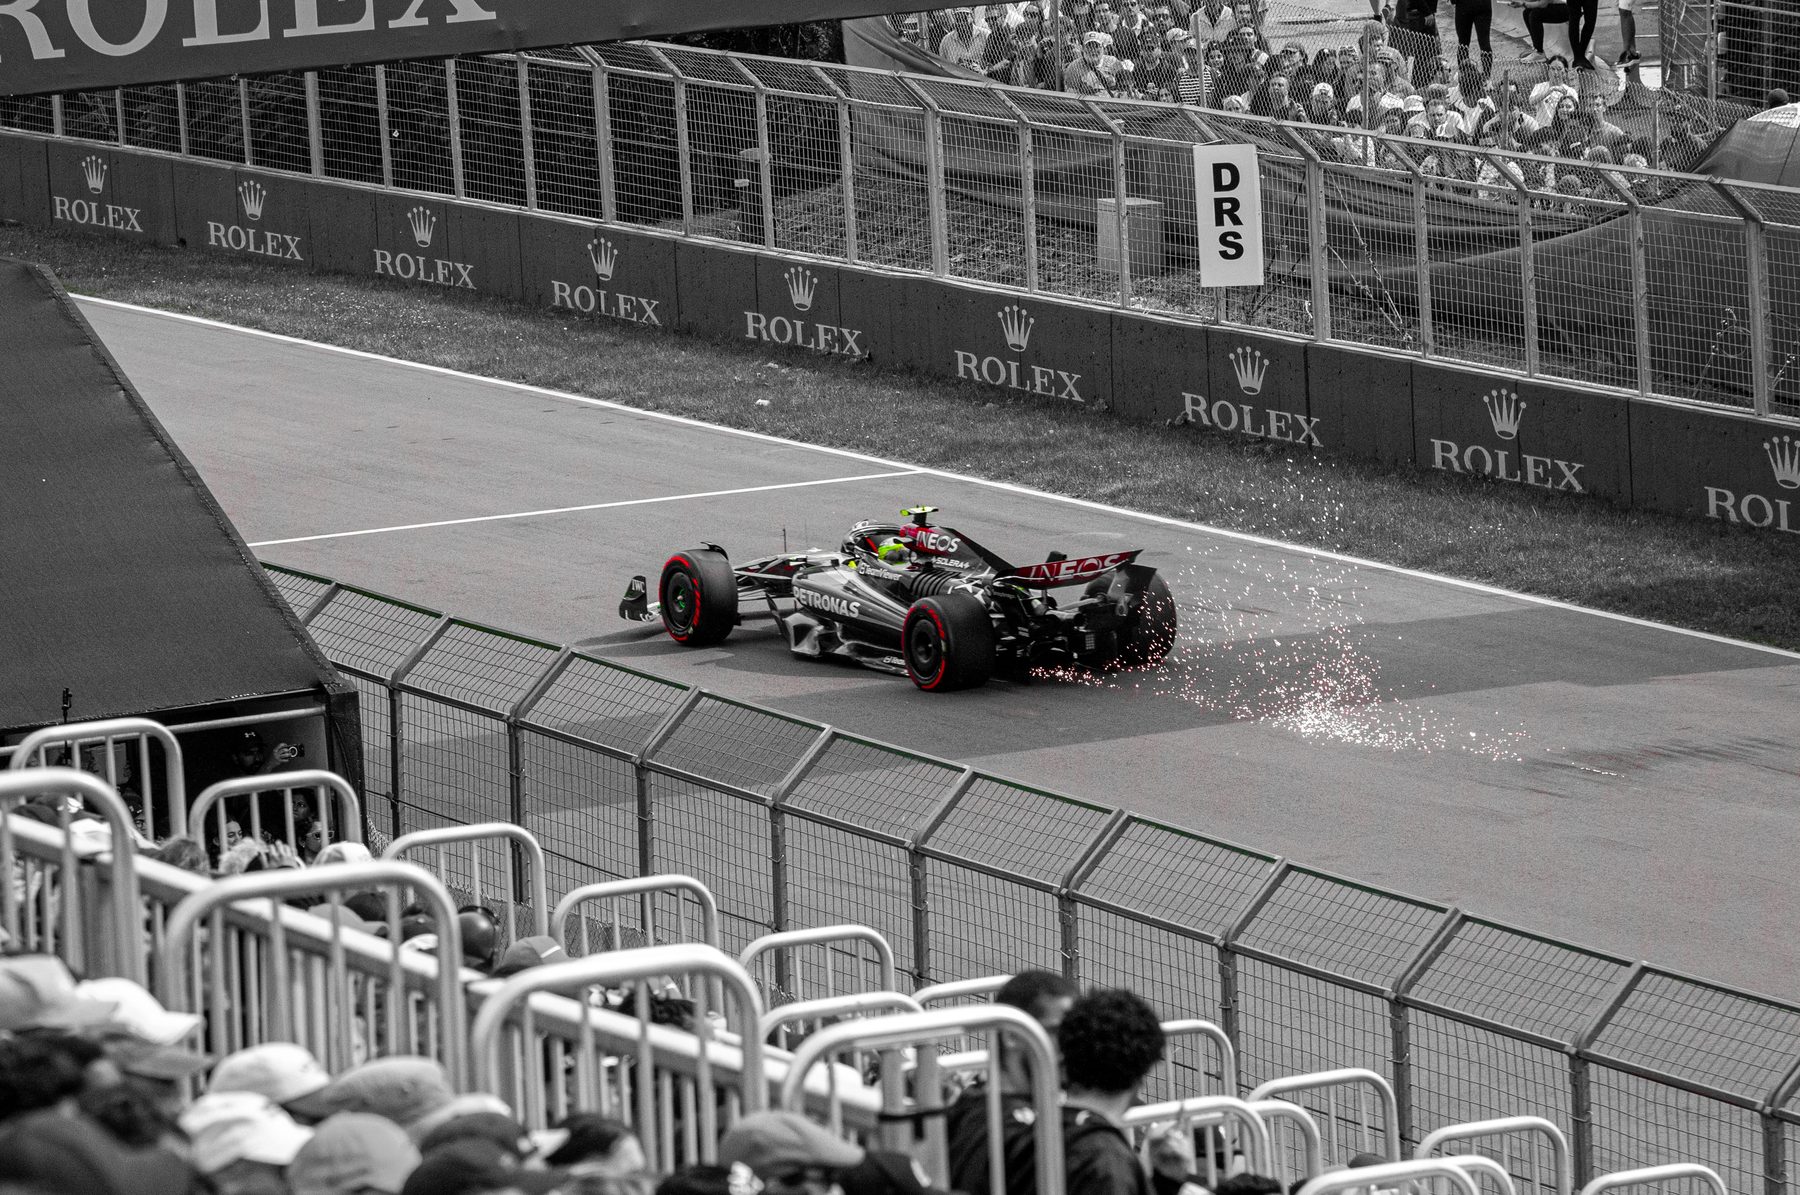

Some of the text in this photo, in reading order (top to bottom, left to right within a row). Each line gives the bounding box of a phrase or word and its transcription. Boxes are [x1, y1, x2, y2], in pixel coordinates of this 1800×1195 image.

[53, 195, 144, 233] ROLEX
[1211, 162, 1244, 261] DRS
[207, 220, 304, 261] ROLEX
[373, 248, 477, 290] ROLEX
[551, 280, 663, 327] ROLEX
[743, 311, 863, 357] ROLEX
[953, 349, 1086, 403] ROLEX
[1181, 391, 1325, 448] ROLEX
[1430, 438, 1587, 494] ROLEX
[916, 530, 962, 553] INEOS
[792, 585, 861, 618] PETRONAS
